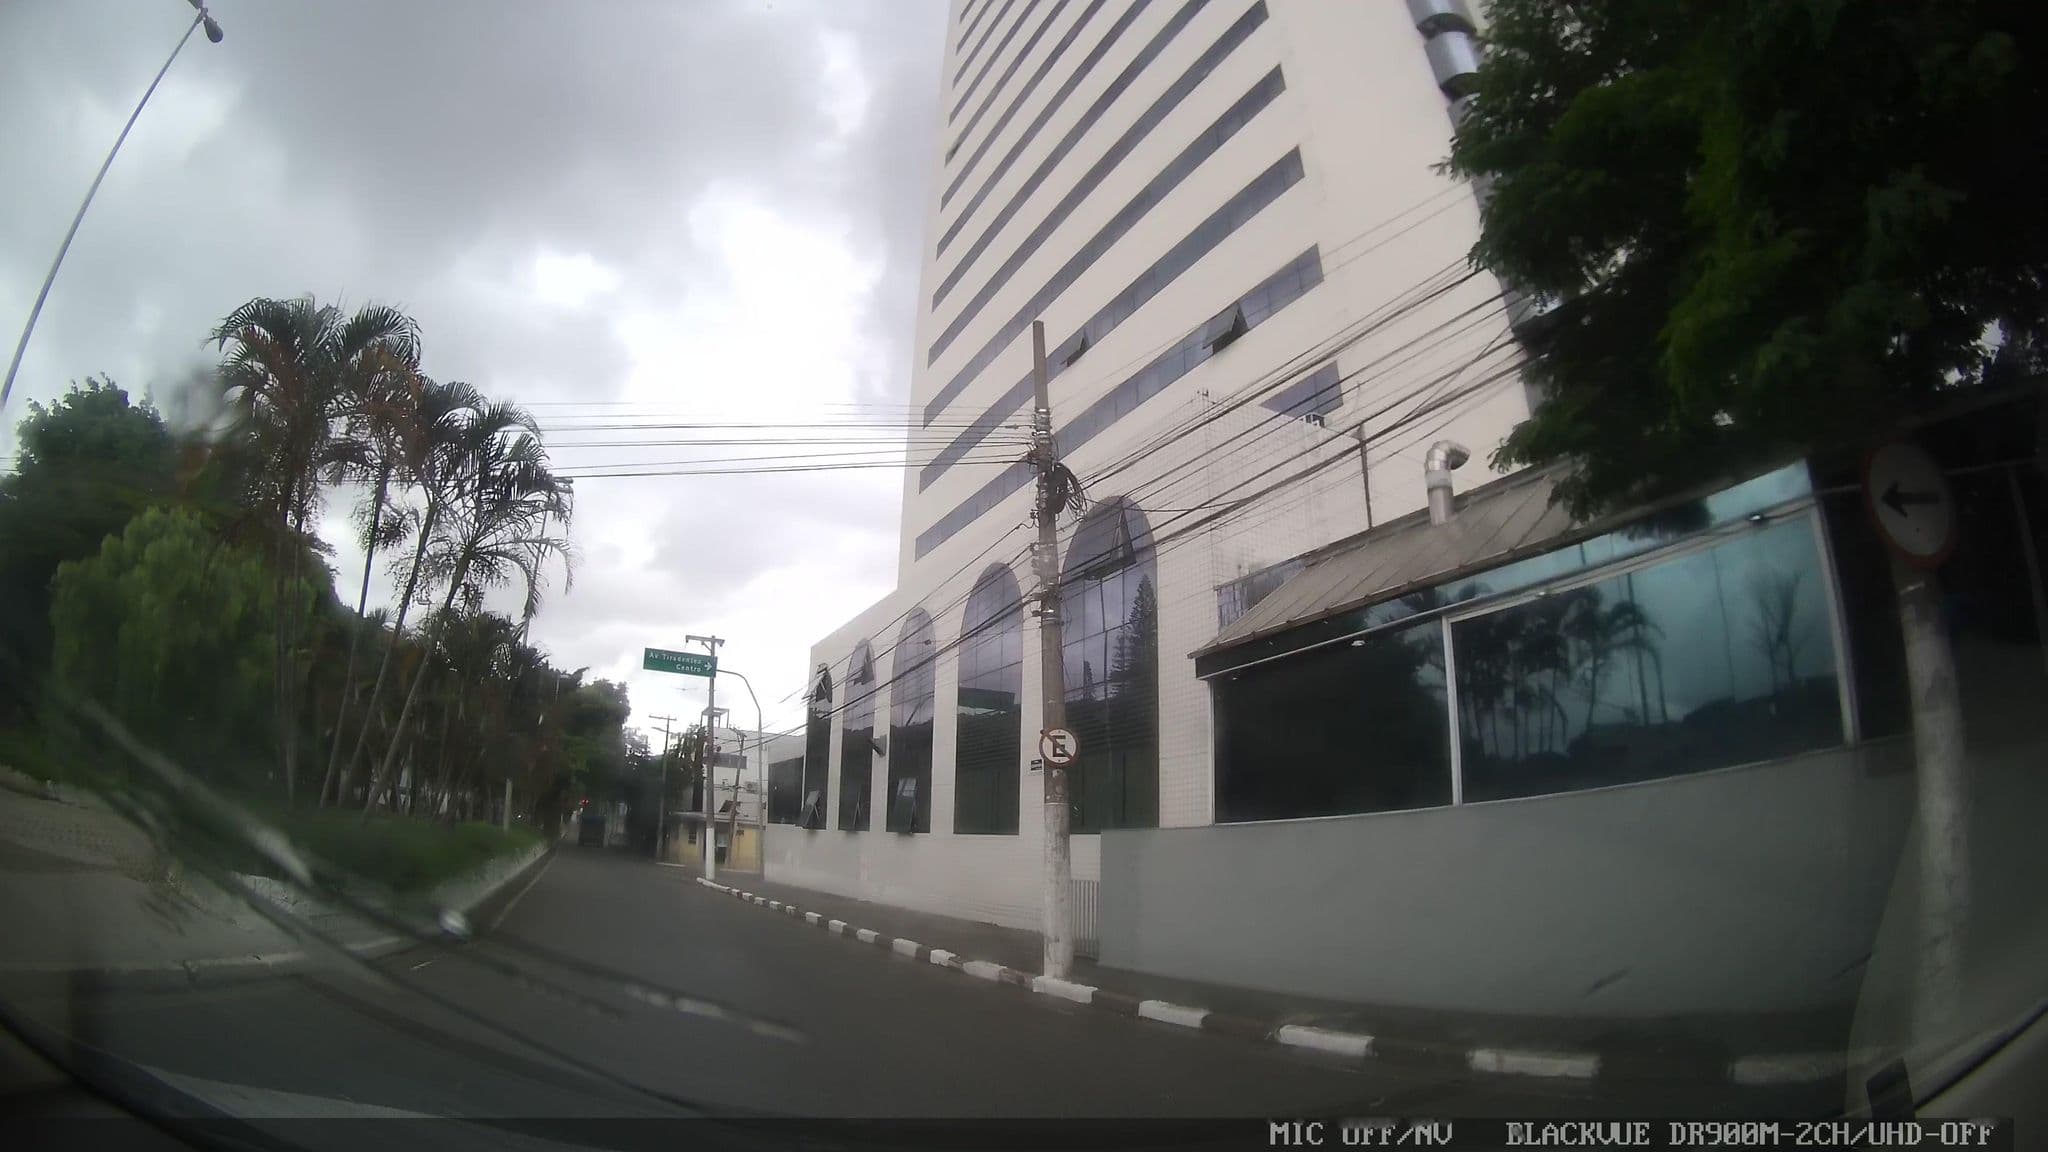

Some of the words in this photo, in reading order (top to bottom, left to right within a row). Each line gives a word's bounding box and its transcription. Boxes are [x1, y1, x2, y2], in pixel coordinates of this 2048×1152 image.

[662, 653, 702, 664] Tiradentes
[676, 663, 702, 673] Centro
[1053, 735, 1066, 757] E
